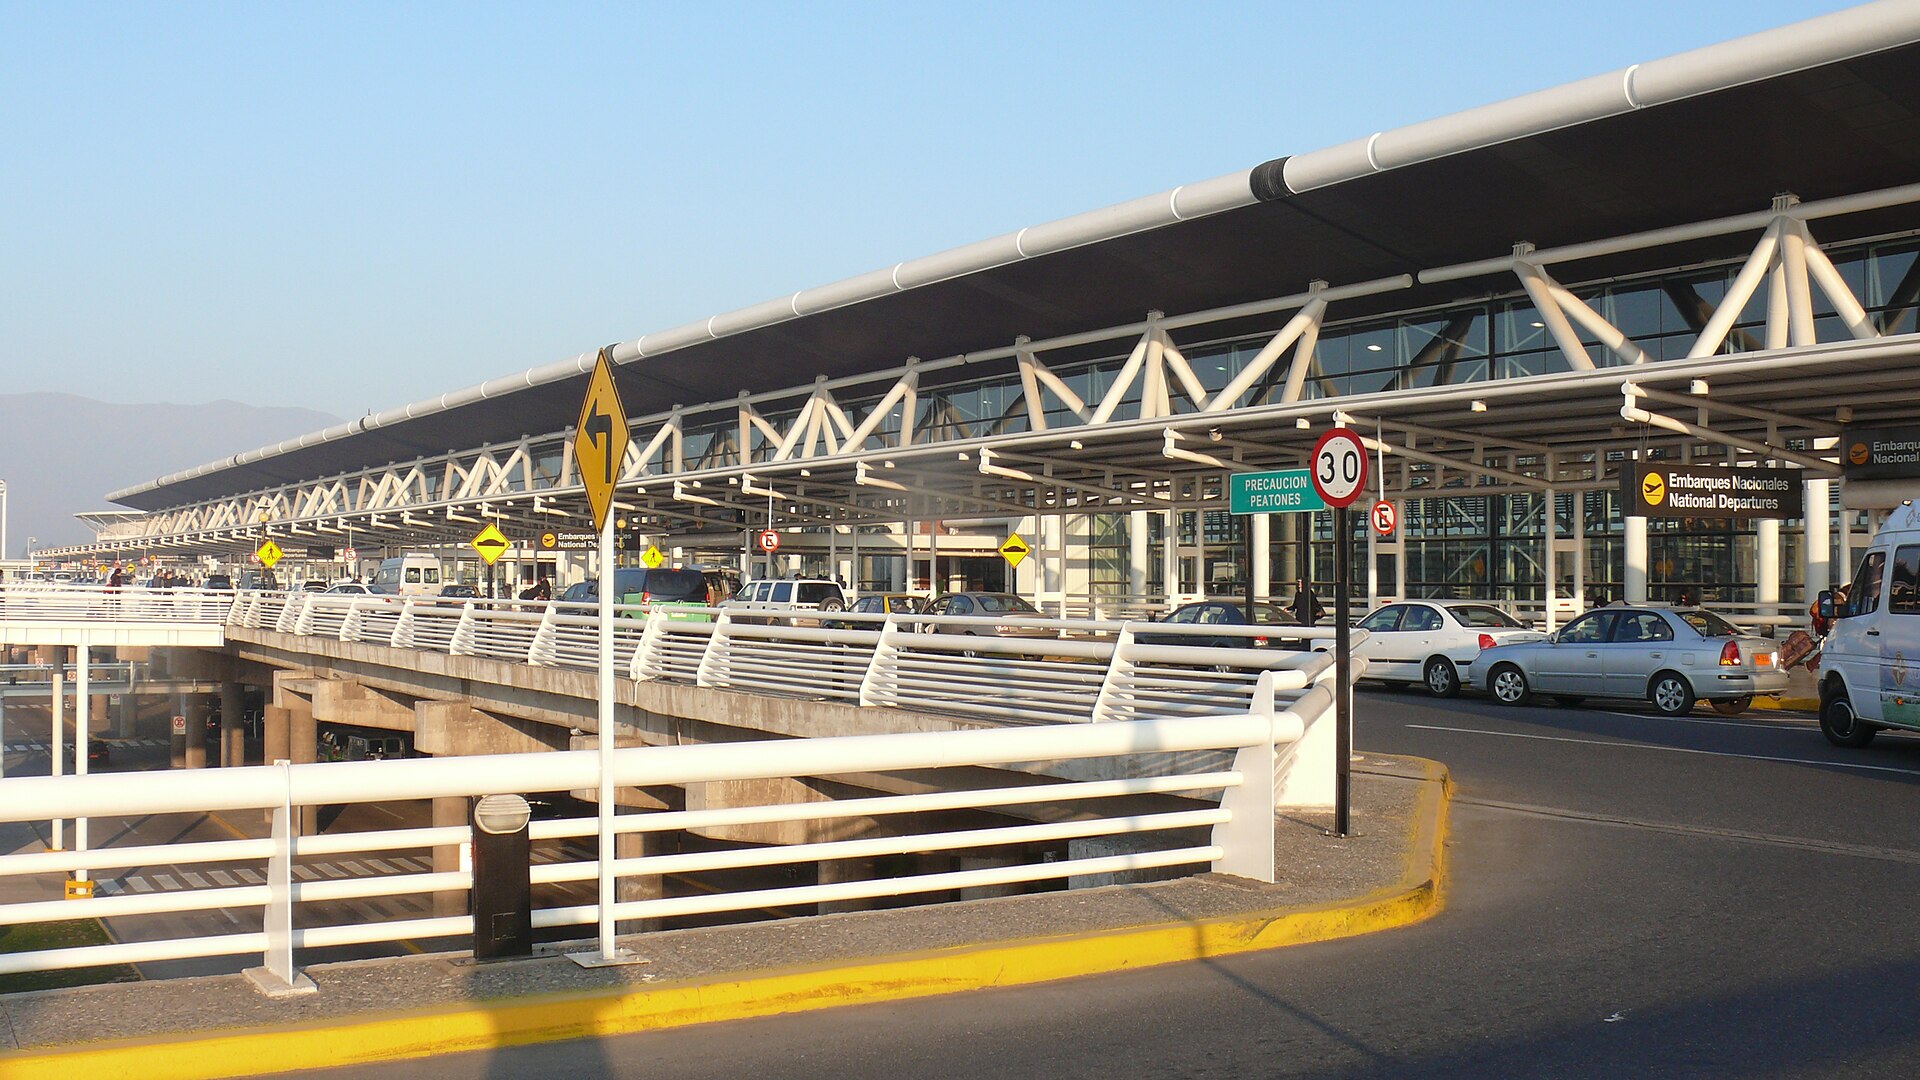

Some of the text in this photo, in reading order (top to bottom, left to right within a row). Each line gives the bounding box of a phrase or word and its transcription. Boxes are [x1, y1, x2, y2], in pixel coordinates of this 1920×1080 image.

[1320, 450, 1358, 484] 30
[1245, 475, 1307, 492] PRECAUCION
[1668, 472, 1789, 492] Embarques Nacionales
[1250, 492, 1301, 507] PEATONES
[1669, 492, 1779, 512] National Departures
[1379, 507, 1389, 528] E
[557, 532, 596, 541] Embarques
